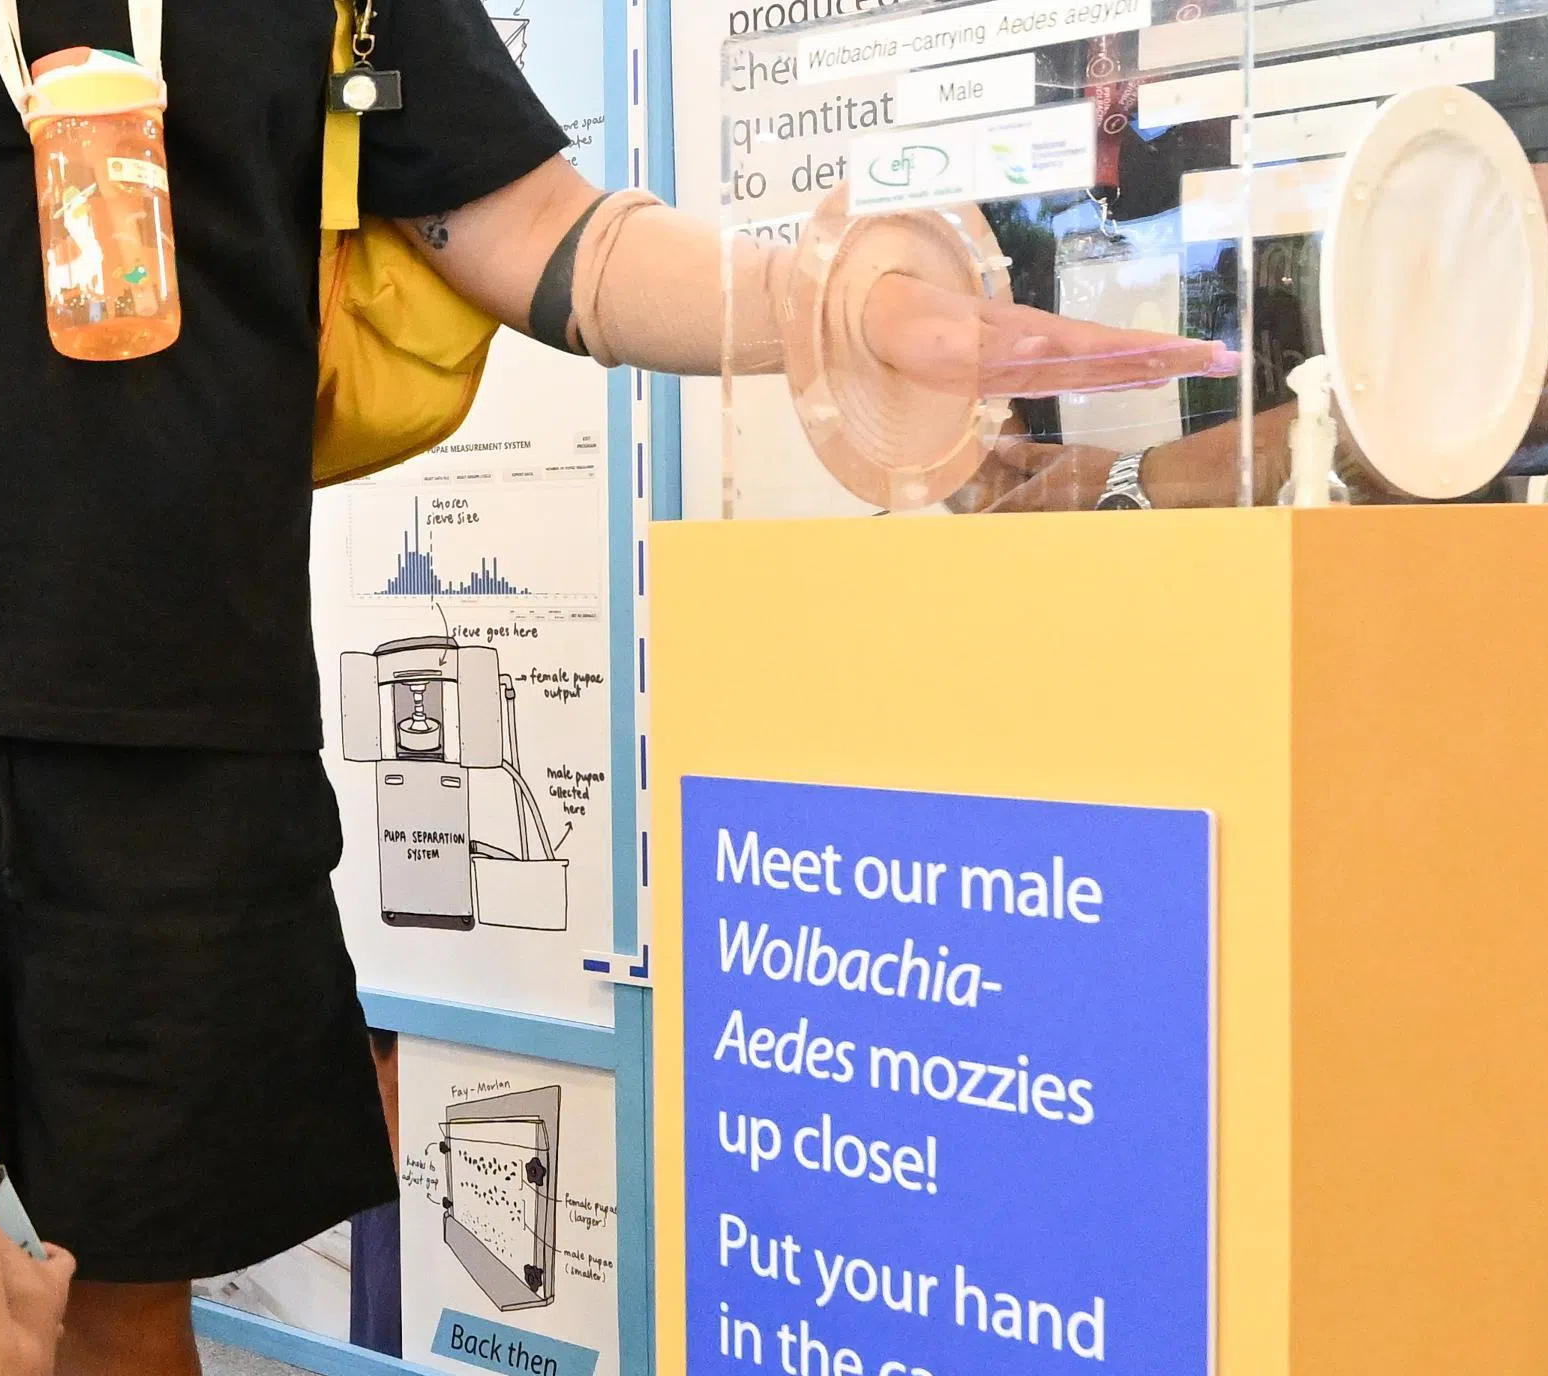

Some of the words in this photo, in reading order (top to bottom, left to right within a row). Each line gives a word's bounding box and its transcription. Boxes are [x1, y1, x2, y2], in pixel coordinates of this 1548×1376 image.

[998, 10, 1059, 36] Aedes
[939, 81, 983, 103] Male
[451, 443, 502, 453] MEASUREMENT
[504, 441, 531, 449] SYSTEM
[432, 498, 468, 508] chosen
[427, 514, 453, 524] sieve
[458, 512, 479, 523] size
[453, 626, 480, 637] sieve
[487, 628, 510, 642] goes
[514, 623, 538, 637] here
[530, 668, 569, 685] female
[572, 674, 603, 689] pupae
[545, 685, 582, 699] output
[385, 830, 407, 844] PUPA
[412, 830, 465, 845] SEPARATION
[407, 848, 439, 861] SYSTEM
[716, 829, 842, 897] Meet
[854, 861, 946, 907] our
[959, 854, 1103, 924] male
[716, 919, 1001, 1008] Wolbachia-
[714, 1011, 855, 1083] Aedes
[869, 1049, 1095, 1125] mozzies
[718, 1110, 779, 1168] up
[793, 1116, 937, 1193] close!
[719, 1216, 800, 1286] Put
[813, 1254, 936, 1323] your
[953, 1272, 1106, 1361] hand
[451, 1324, 501, 1361] Back
[719, 1305, 763, 1364] in
